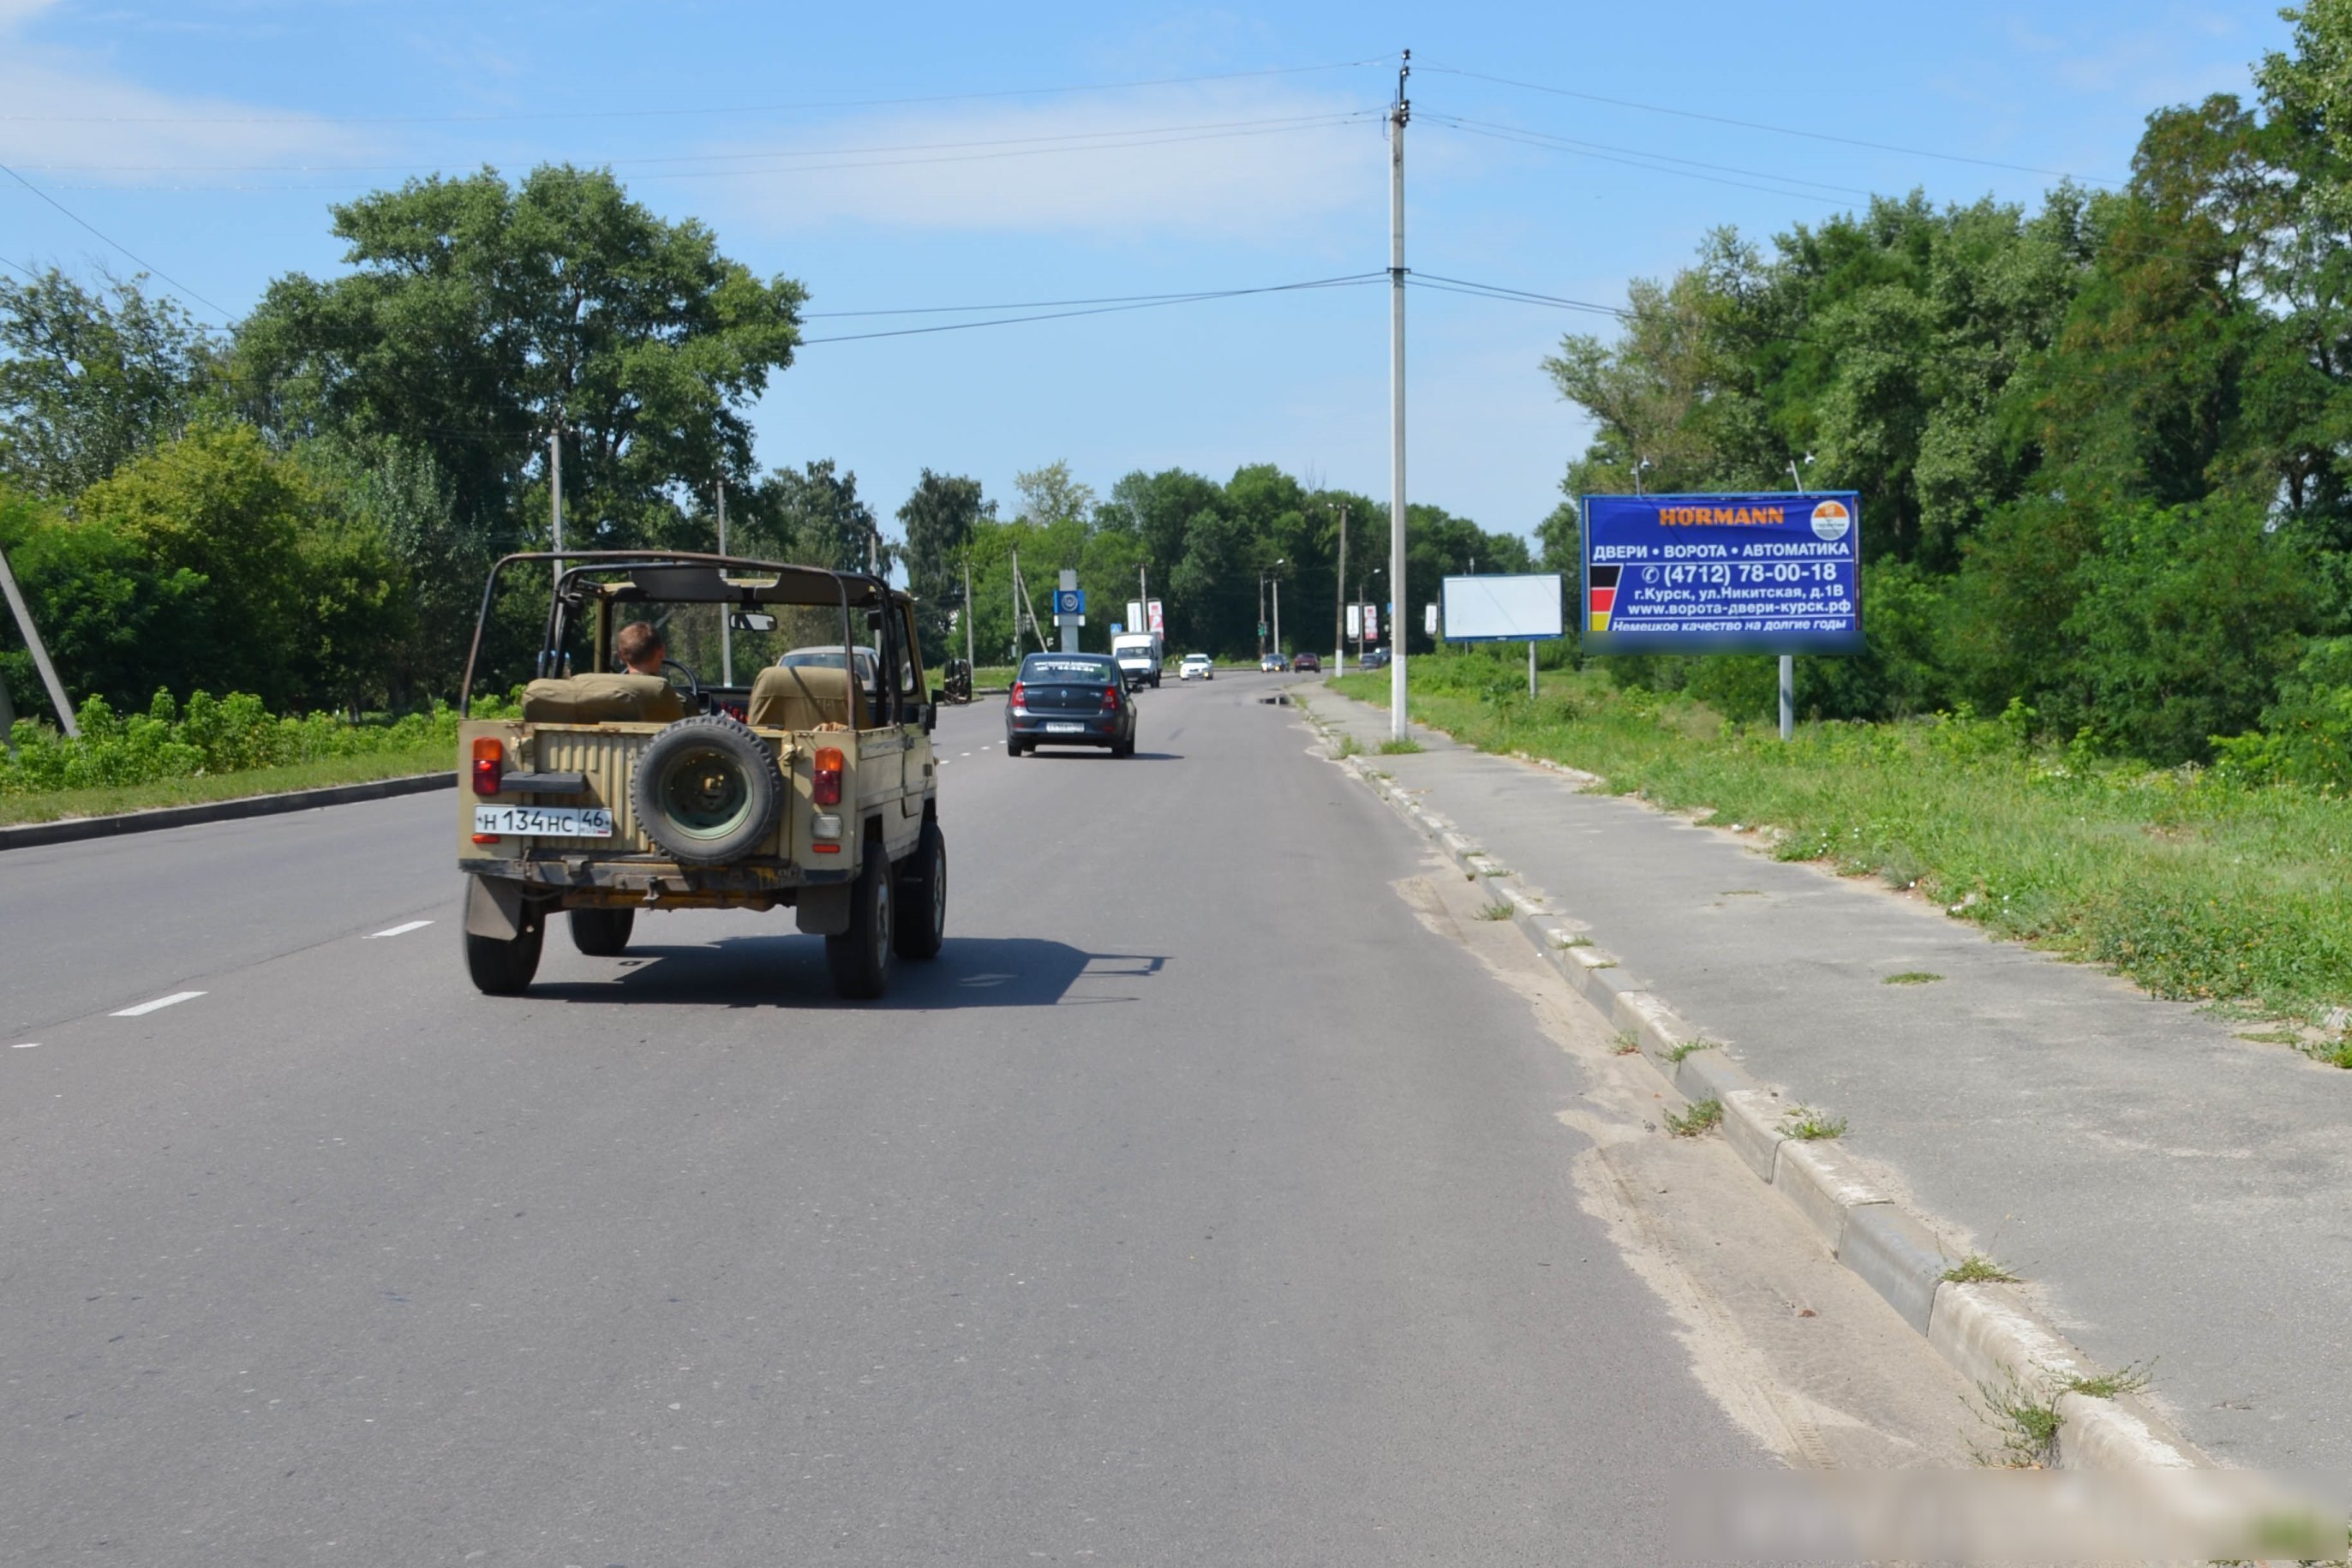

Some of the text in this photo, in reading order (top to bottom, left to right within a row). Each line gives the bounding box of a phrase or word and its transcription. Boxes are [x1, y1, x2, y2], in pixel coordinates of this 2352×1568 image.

[1593, 542, 1850, 561] ДВЕРИ ВОРОТА АВТОМАТИКА
[1664, 563, 1837, 587] (4712) 78-00-18
[1634, 584, 1844, 602] г.Курск, ул.Никитская, д.1В
[1627, 599, 1852, 616] www.ворота-двери-курск.рф
[1613, 619, 1847, 631] Немецкое качество на долгие годы
